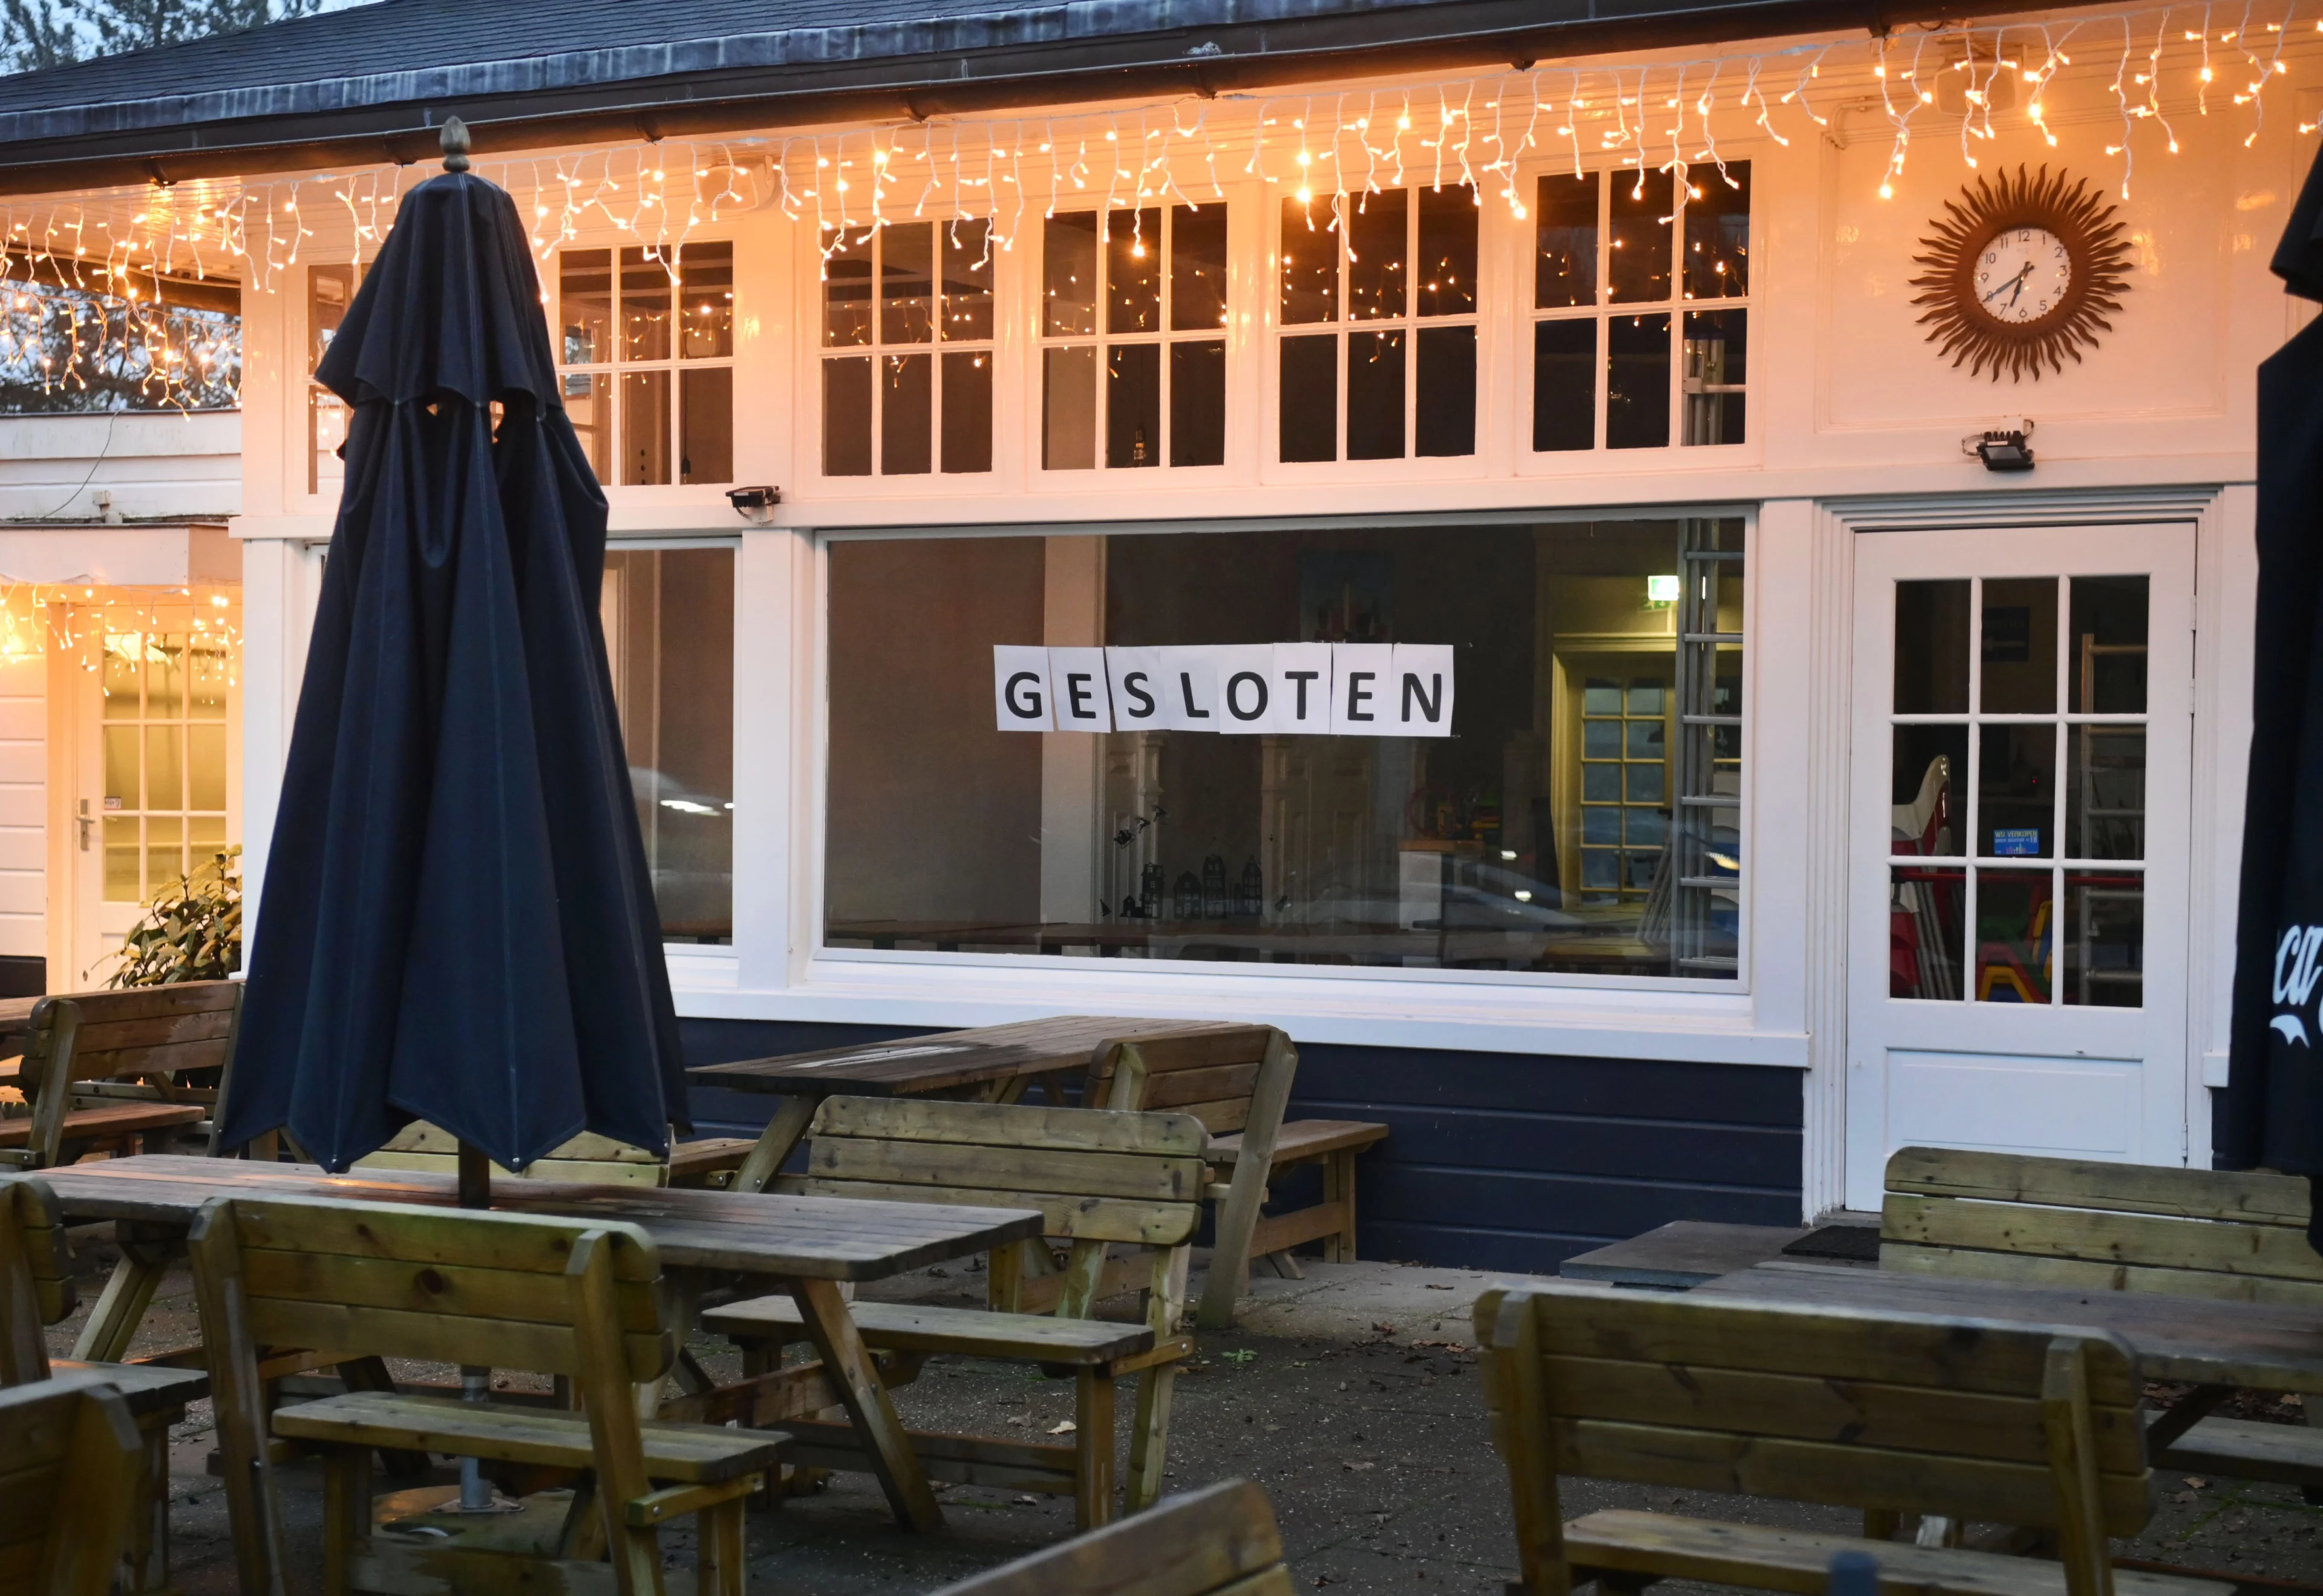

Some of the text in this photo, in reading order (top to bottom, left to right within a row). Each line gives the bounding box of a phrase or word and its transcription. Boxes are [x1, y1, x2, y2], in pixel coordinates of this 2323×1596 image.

[2018, 231, 2030, 243] 12
[2042, 234, 2046, 245] 1
[2001, 237, 2008, 249] 11
[1985, 252, 1996, 264] 10
[2054, 247, 2063, 258] 2
[2060, 265, 2067, 276] 3
[1981, 272, 1989, 283] 9
[2053, 286, 2061, 296] 4
[2000, 304, 2007, 315] 7
[2039, 300, 2047, 311] 5
[2019, 307, 2027, 318] 6
[1005, 671, 1442, 722] GESLOTEN
